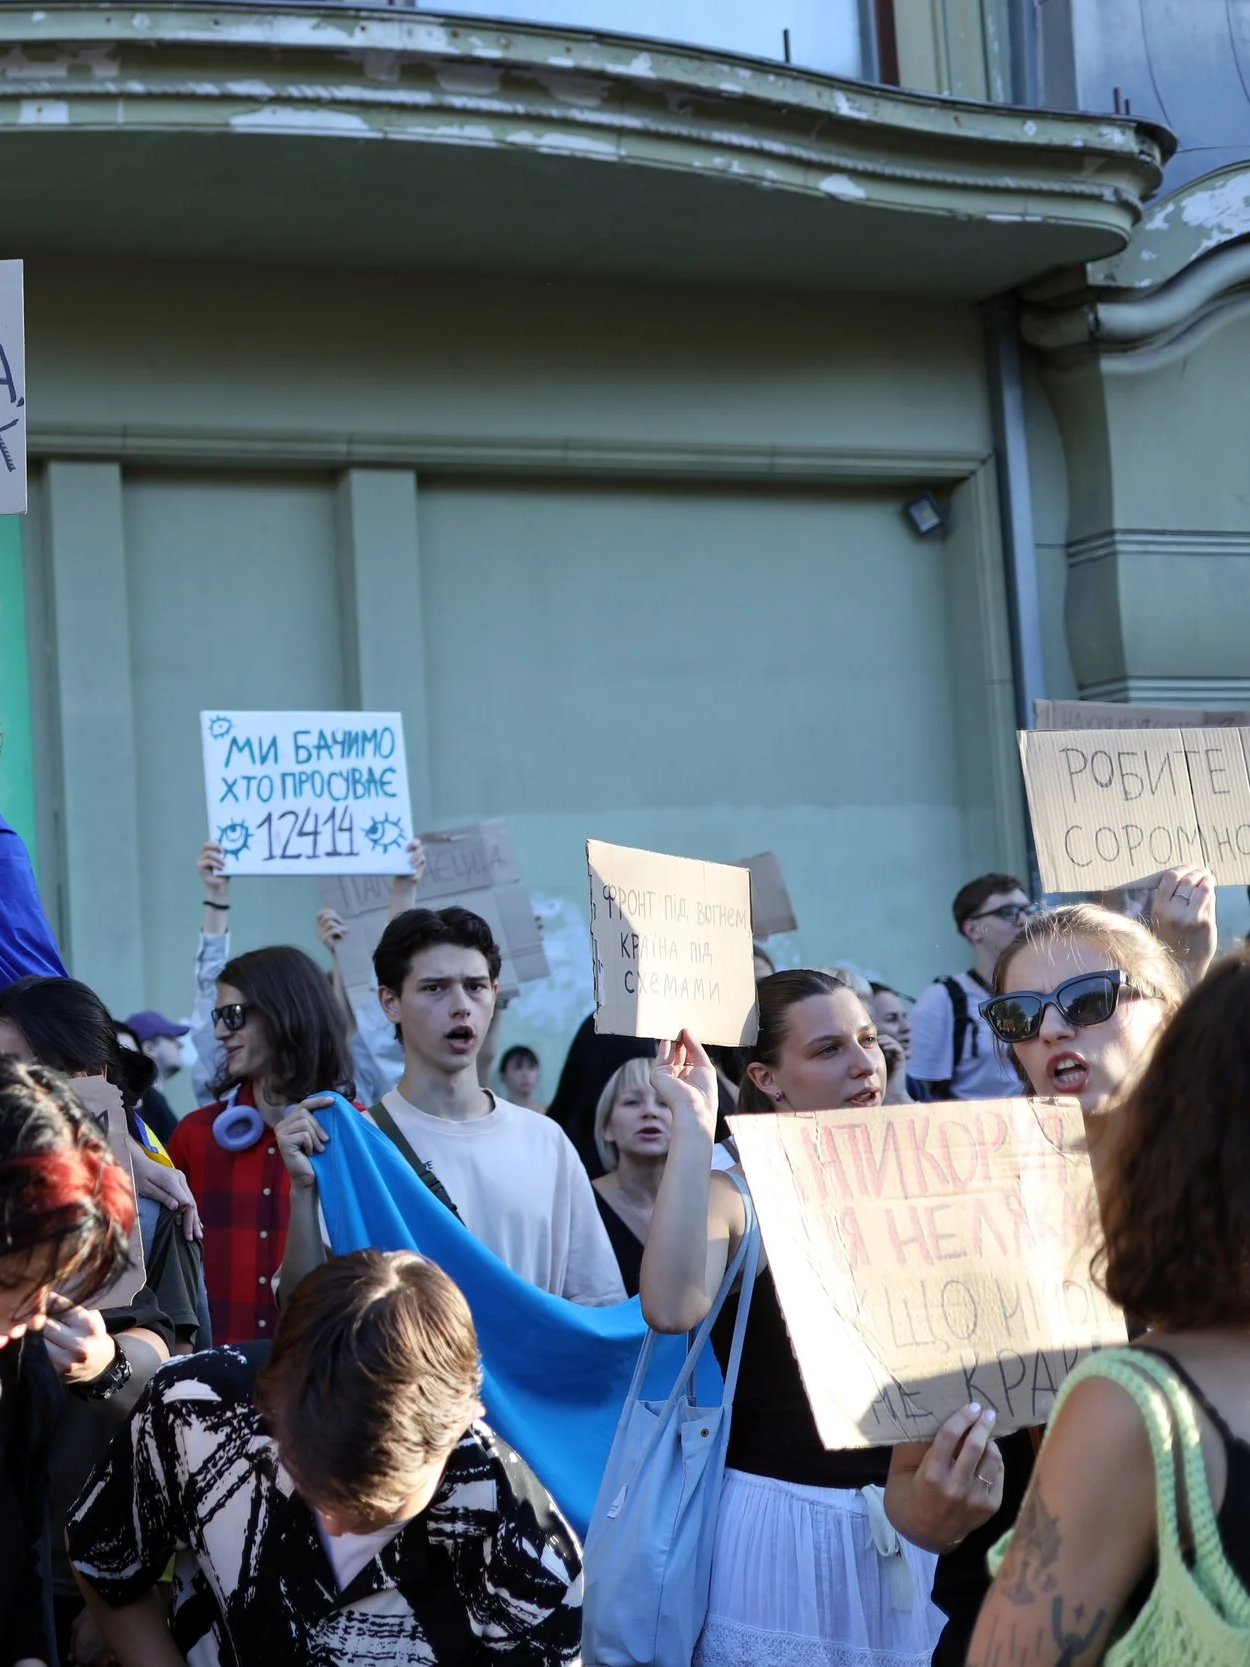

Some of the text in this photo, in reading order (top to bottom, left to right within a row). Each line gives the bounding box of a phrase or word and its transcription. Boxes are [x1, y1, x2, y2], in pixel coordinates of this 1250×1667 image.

[224, 726, 395, 768] МИ БАЧИМО
[219, 767, 397, 803] ХТО ПРОСУВАЄ
[1059, 747, 1230, 803] РОБИТЕ
[255, 805, 360, 861] 12414
